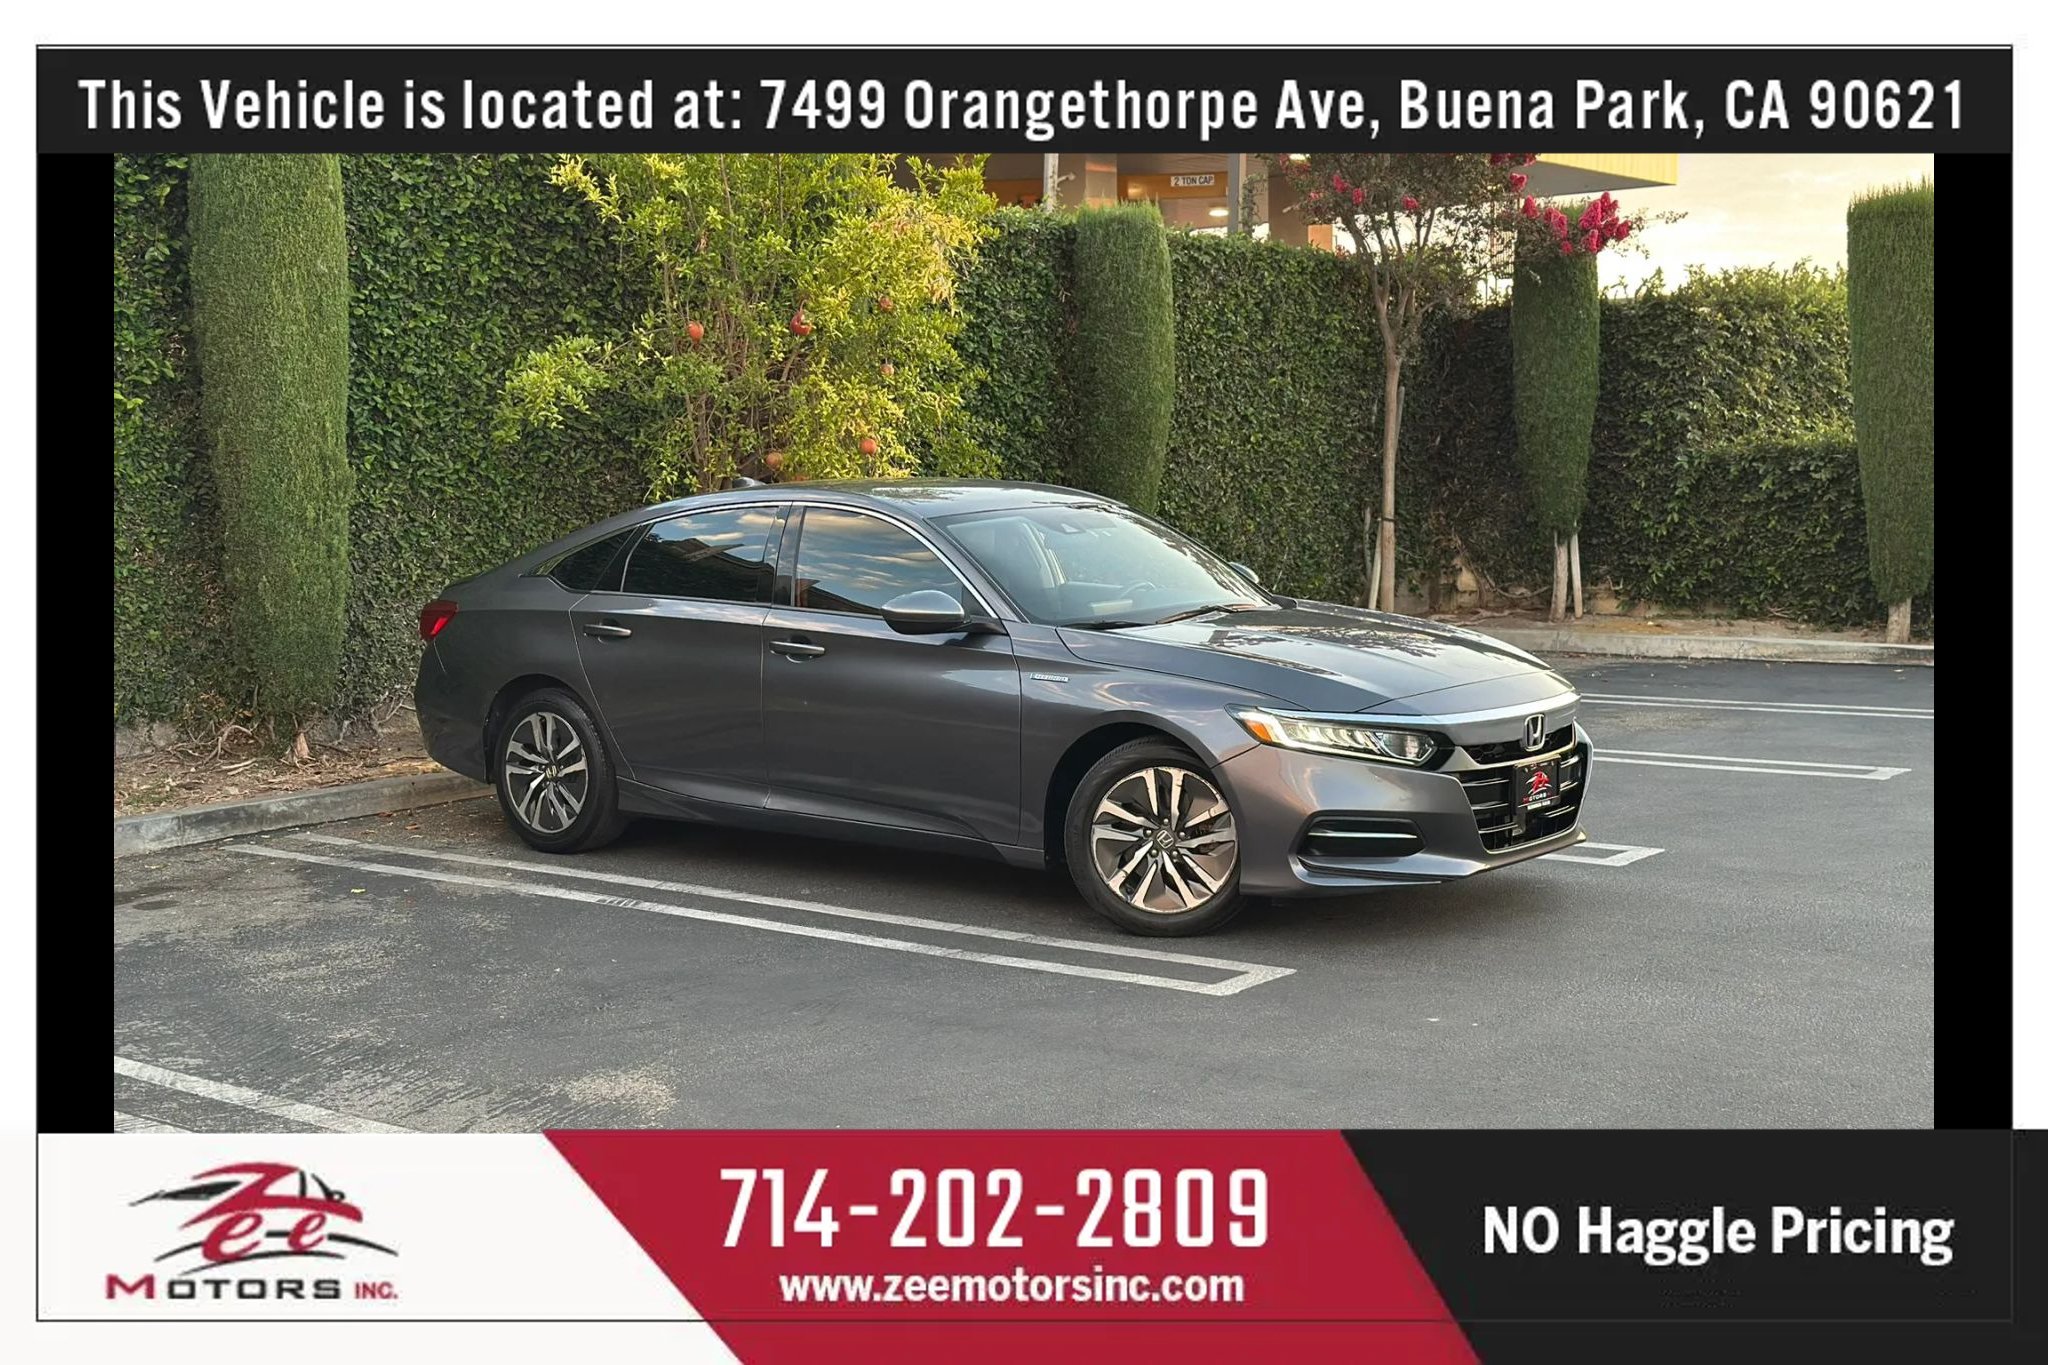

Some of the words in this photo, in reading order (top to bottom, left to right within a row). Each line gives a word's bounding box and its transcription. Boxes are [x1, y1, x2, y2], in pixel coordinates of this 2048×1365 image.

[1174, 176, 1180, 186] 2
[1182, 176, 1197, 185] TON
[1198, 175, 1213, 185] CAP
